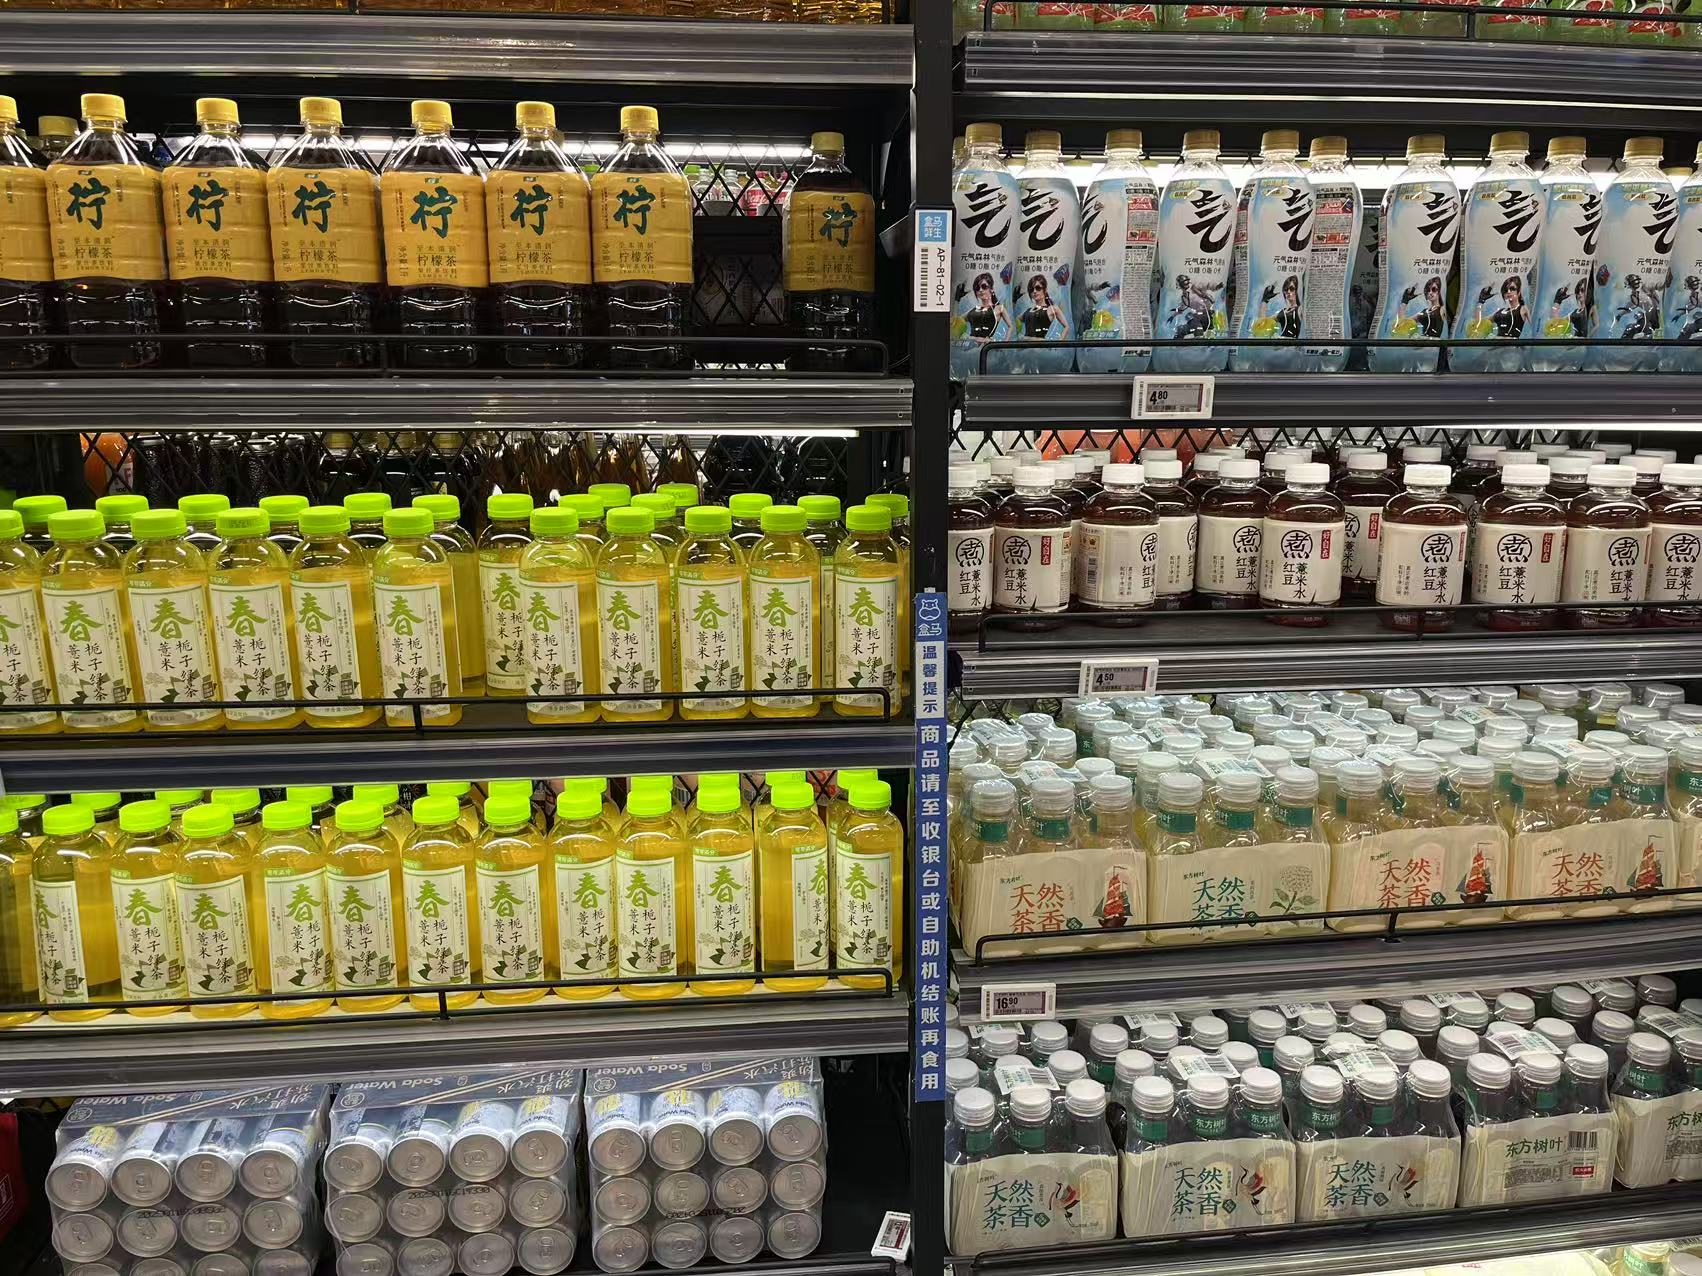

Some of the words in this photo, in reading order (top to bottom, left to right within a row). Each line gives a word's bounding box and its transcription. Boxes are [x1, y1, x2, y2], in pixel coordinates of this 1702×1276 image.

[66, 177, 110, 230] 柠
[186, 179, 229, 232] 柠
[292, 180, 337, 233] 柠
[410, 186, 458, 238] 柠
[510, 184, 552, 235] 柠
[613, 184, 656, 236] 柠
[923, 216, 943, 227] 盒马
[74, 247, 112, 259] 柠檬茶
[193, 246, 231, 260] 柠檬茶
[300, 248, 338, 261] 柠檬茶
[417, 255, 456, 267] 柠檬茶
[515, 251, 552, 264] 柠檬茶
[619, 251, 654, 263] 柠檬茶
[960, 252, 991, 261] 元气森林
[1016, 256, 1043, 264] 元气森林
[1184, 257, 1214, 265] 元气森林
[1273, 256, 1300, 264] 元气森林
[1413, 258, 1442, 266] 元气森林
[1489, 257, 1521, 265] 元气森林
[936, 247, 946, 307] AP-81-02-1
[956, 537, 984, 567] 煮
[1002, 535, 1031, 565] 煮
[1233, 525, 1262, 553] 煮
[1280, 529, 1313, 559] 煮
[1421, 533, 1453, 563] 煮
[1497, 533, 1532, 563] 煮
[1608, 536, 1640, 567] 煮
[1664, 533, 1700, 563] 煮
[1235, 556, 1247, 579] 红豆
[1342, 541, 1355, 573] 薏米水
[959, 570, 971, 594] 红豆
[971, 569, 982, 606] 薏米水
[1004, 567, 1016, 591] 红豆
[1015, 567, 1027, 605] 薏米水
[1142, 565, 1152, 588] 红豆
[1246, 556, 1258, 590] 薏米水
[1282, 562, 1295, 586] 红豆
[1294, 562, 1308, 600] 薏米水
[1422, 566, 1436, 591] 红豆
[1434, 566, 1448, 603] 薏米水
[1498, 567, 1512, 591] 红豆
[1511, 566, 1527, 604] 薏米水
[1609, 570, 1623, 594] 红豆
[1664, 566, 1680, 590] 红豆
[1677, 566, 1694, 600] 薏米水
[491, 572, 520, 611] 春
[847, 586, 884, 627] 春
[60, 600, 104, 642] 春
[149, 598, 194, 640] 春
[227, 595, 268, 637] 春
[298, 592, 334, 634] 春
[386, 594, 424, 636] 春
[527, 591, 560, 633] 春
[607, 591, 641, 632] 春
[691, 589, 728, 629] 春
[761, 587, 798, 628] 春
[918, 623, 942, 636] 盒马
[922, 645, 938, 713] 温馨提示
[1379, 858, 1432, 886] 天然
[1551, 852, 1604, 879] 天然
[572, 872, 607, 909] 春
[625, 869, 660, 908] 春
[708, 865, 743, 903] 春
[845, 862, 878, 901] 春
[1010, 882, 1065, 911] 天然
[1193, 877, 1245, 905] 天然
[1377, 883, 1431, 909] 茶香
[124, 888, 164, 926] 春
[190, 893, 229, 931] 春
[285, 883, 322, 923] 春
[338, 885, 375, 923] 春
[415, 880, 449, 918] 春
[488, 879, 525, 918] 春
[920, 725, 940, 1090] 商品请至收银台或自助机结账再食用
[1009, 909, 1065, 934] 茶香
[401, 1076, 442, 1088] Soda
[595, 1066, 642, 1077] Water
[646, 1062, 688, 1073] Soda
[135, 1092, 177, 1105] Soda
[348, 1079, 396, 1090] Water
[76, 1094, 127, 1106] Water
[1505, 1137, 1564, 1158] 东方树叶
[1173, 1166, 1223, 1192] 天然
[1327, 1160, 1376, 1185] 天然
[984, 1179, 1035, 1207] 天然
[1170, 1190, 1223, 1217] 茶香
[1323, 1183, 1373, 1208] 茶香
[983, 1204, 1034, 1231] 茶香
